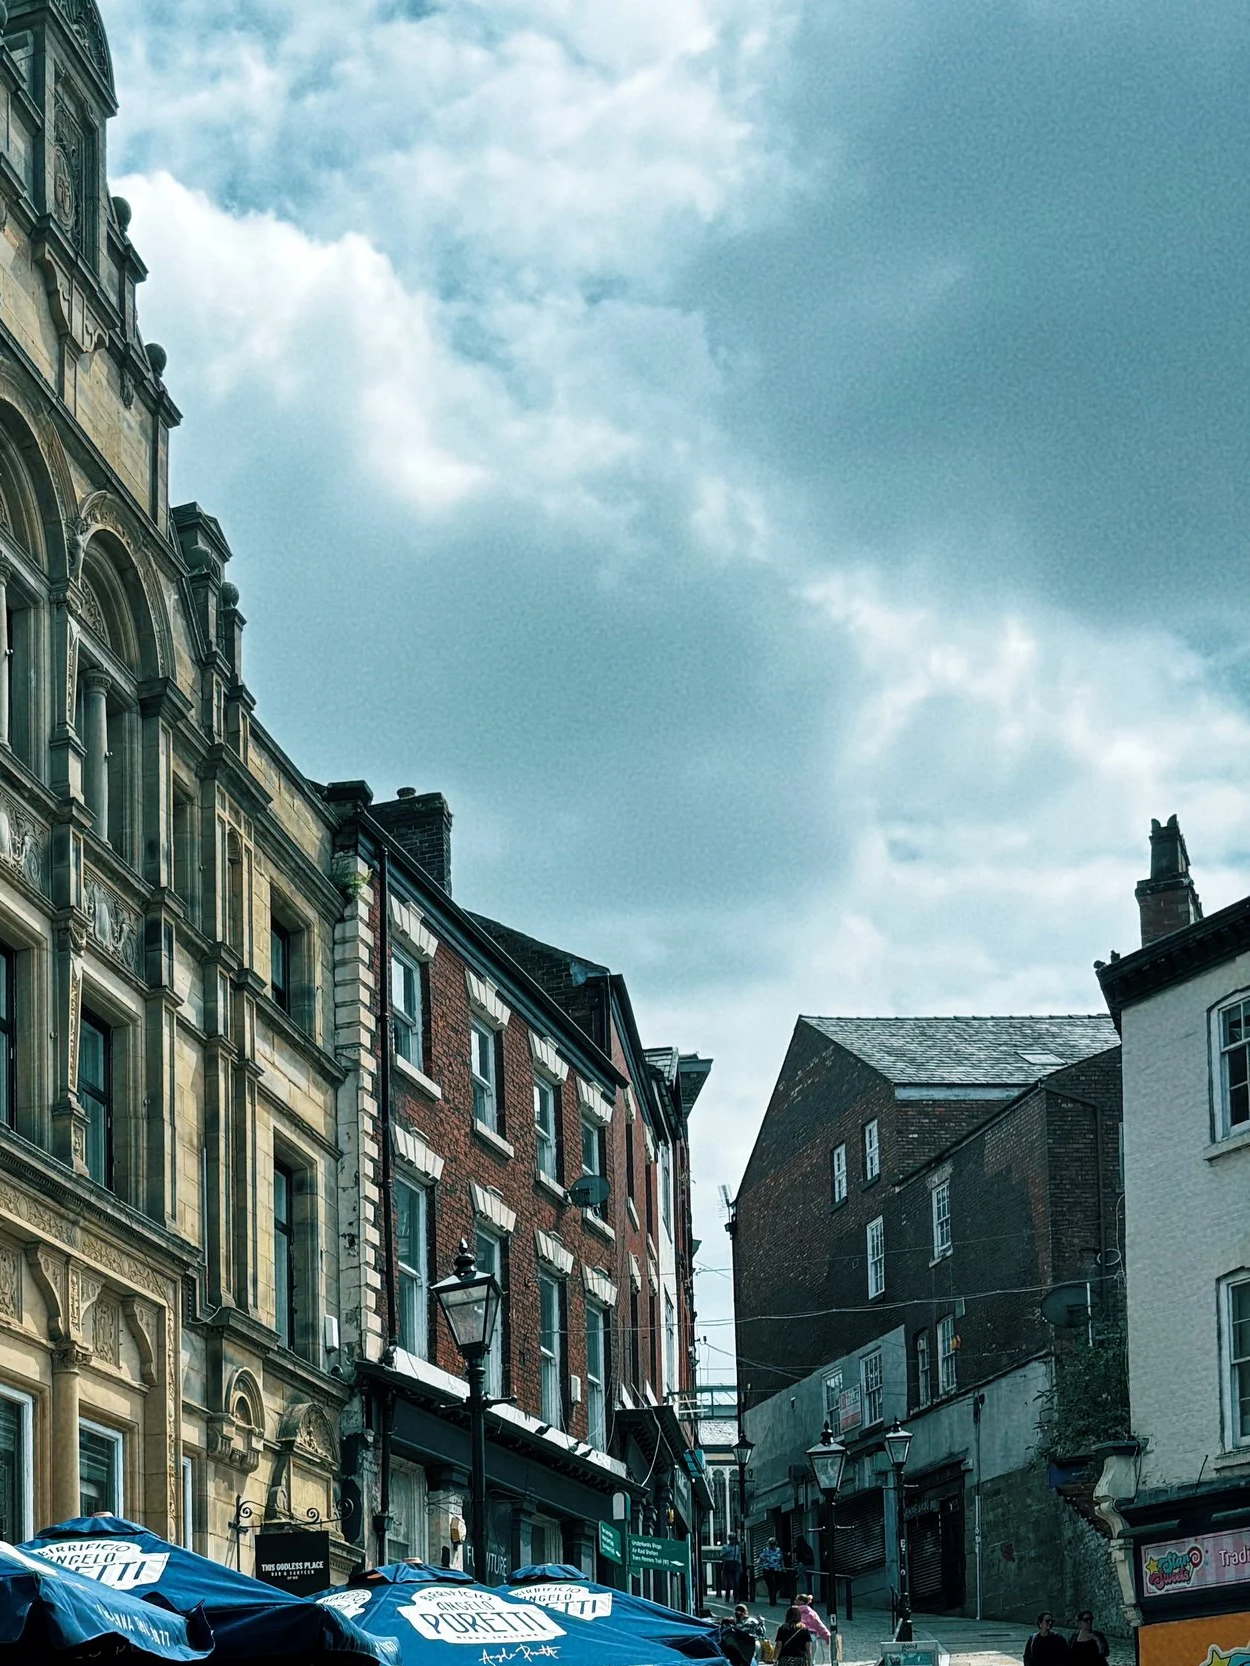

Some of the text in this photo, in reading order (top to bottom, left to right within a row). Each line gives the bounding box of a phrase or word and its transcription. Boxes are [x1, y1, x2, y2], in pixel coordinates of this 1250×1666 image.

[50, 1552, 116, 1565] NGELO
[261, 1561, 324, 1572] THIS GODLESS PLACE
[437, 1600, 495, 1611] ANGELO
[419, 1612, 547, 1634] PORETTI
